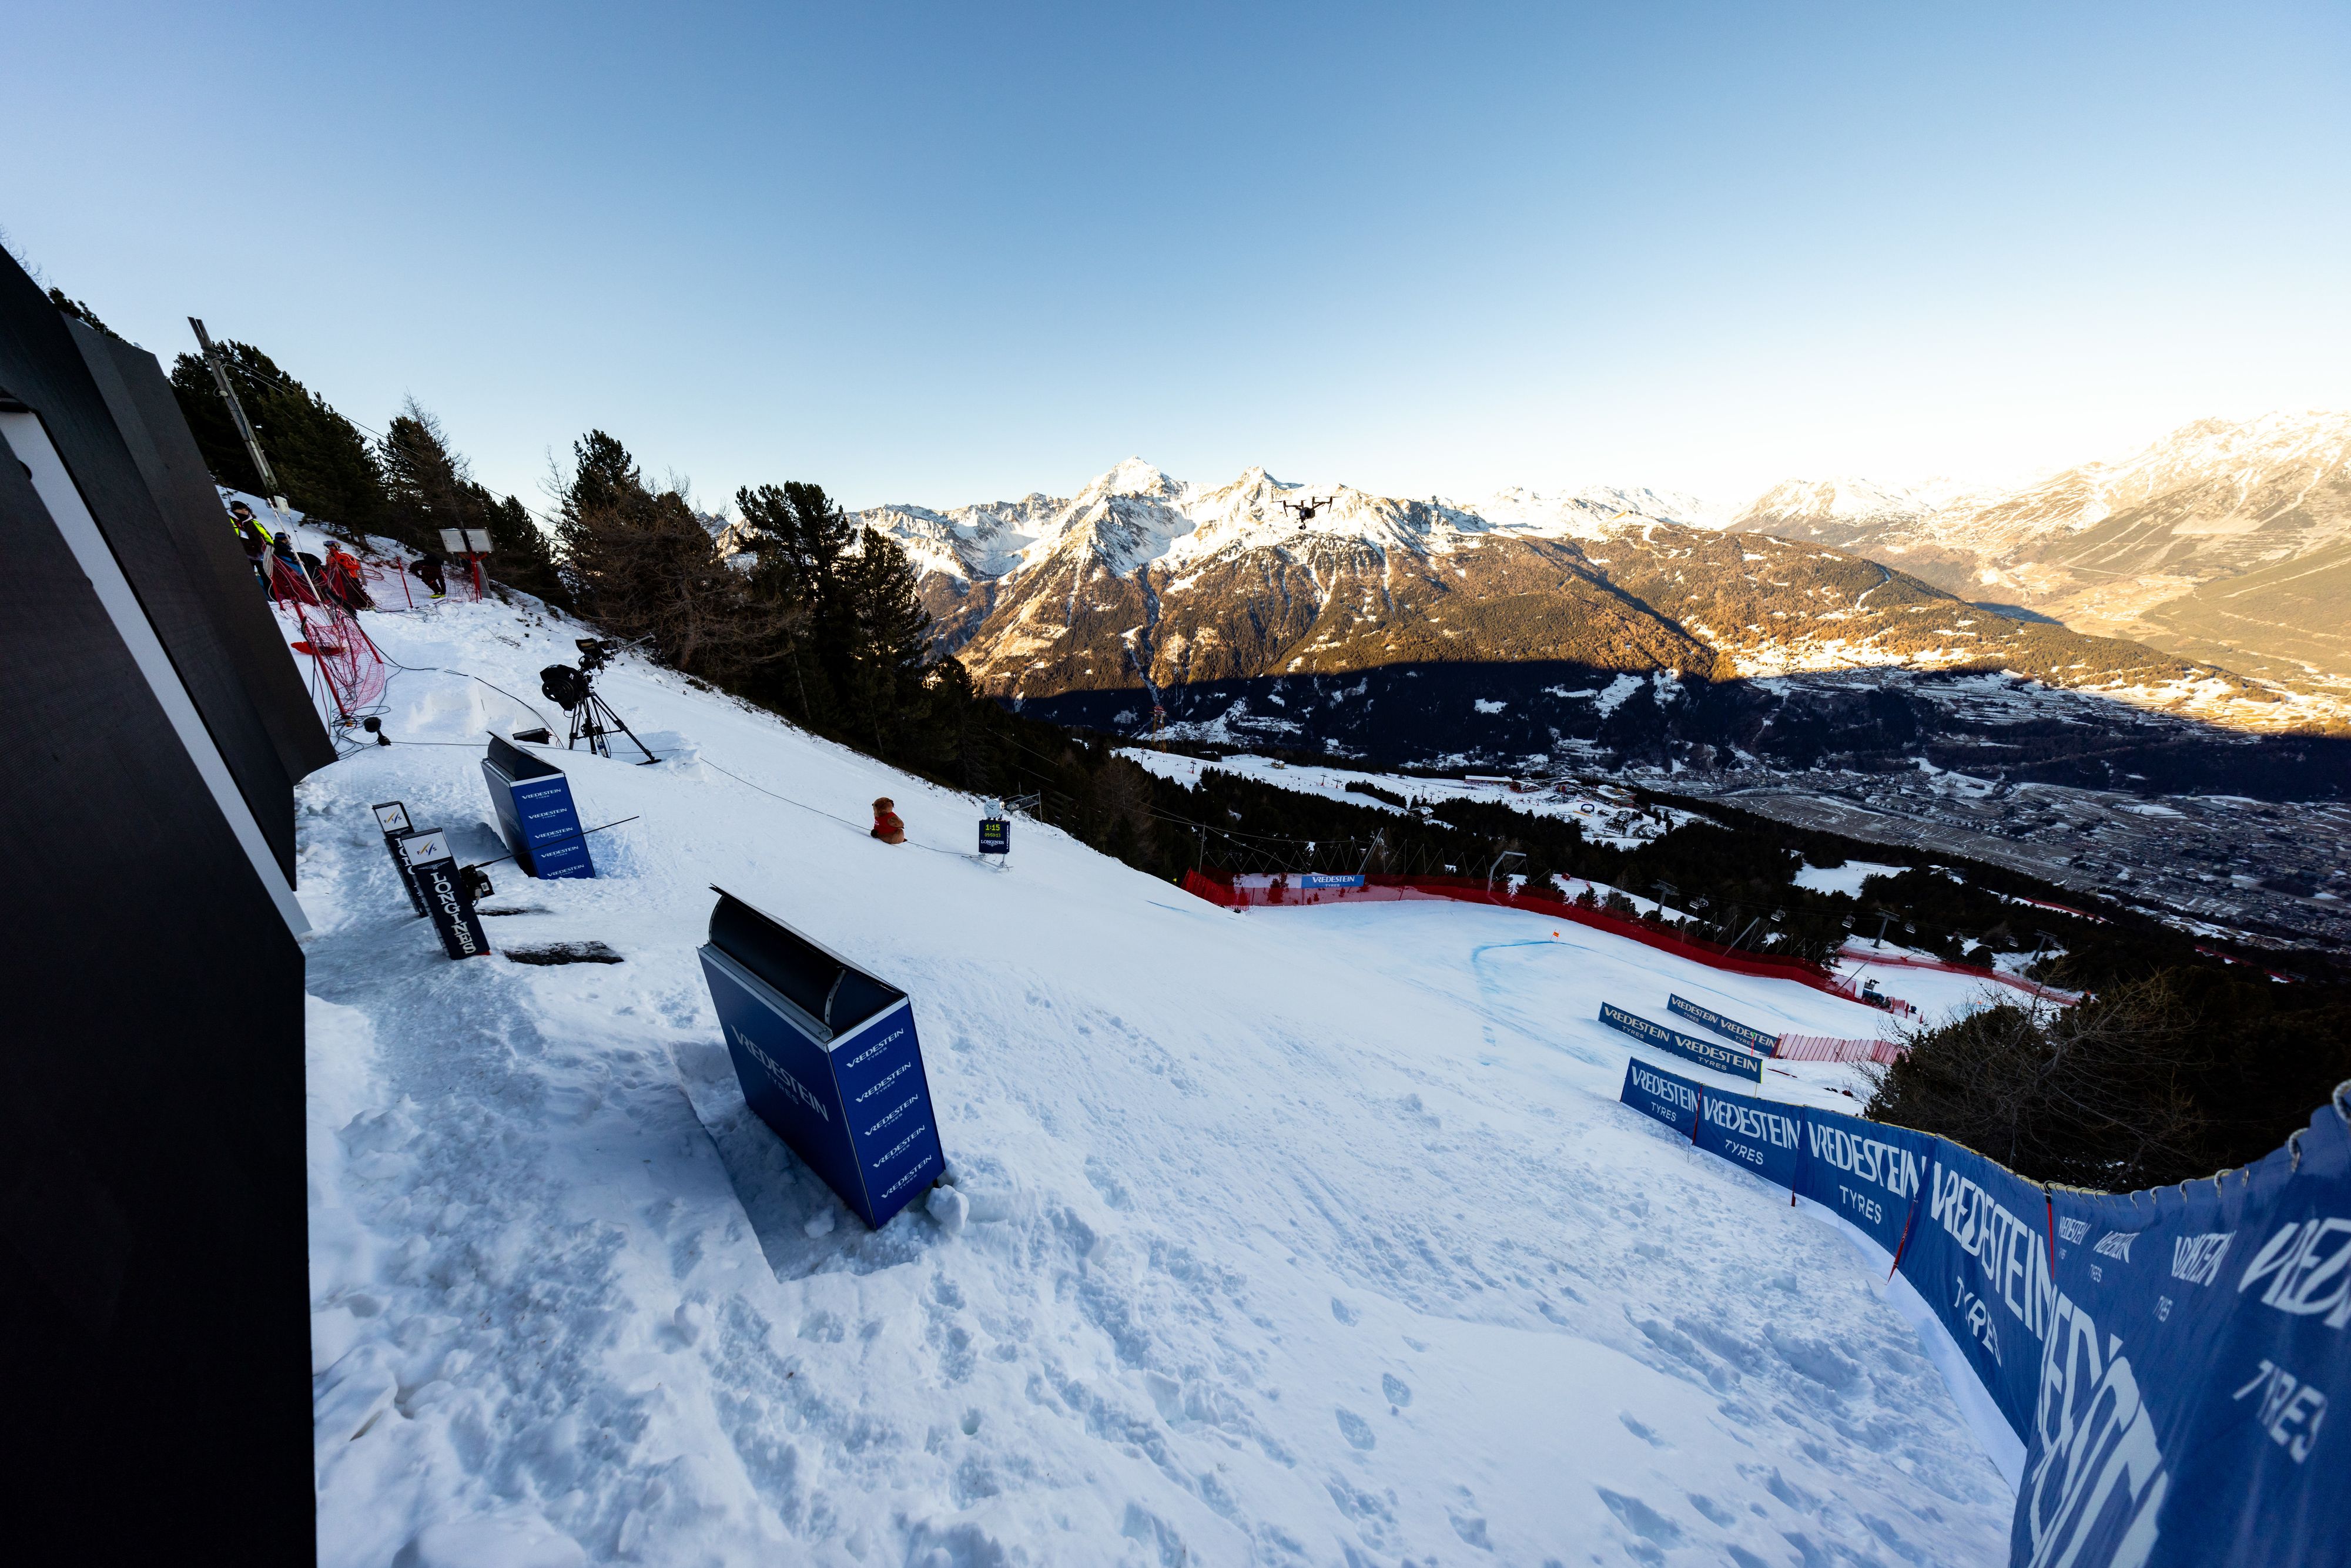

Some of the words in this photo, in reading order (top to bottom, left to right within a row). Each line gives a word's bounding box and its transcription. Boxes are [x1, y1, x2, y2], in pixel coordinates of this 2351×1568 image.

[522, 788, 561, 799] VREDESTEIN
[528, 808, 567, 819] VREDESTEIN
[534, 827, 573, 839] VREDESTEIN
[541, 846, 579, 858] VREDESTEIN
[547, 864, 584, 877] VREDESTEIN
[430, 872, 477, 954] LONGINES
[1671, 996, 1719, 1023] VREDESTEIN
[1683, 1011, 1699, 1022] TYRES
[1604, 1006, 1670, 1042] VREDESTEIN
[1622, 1026, 1644, 1039] TYRES
[1721, 1019, 1776, 1048] VREDESTEIN
[846, 1028, 904, 1068] VREDESTEIN
[867, 1047, 887, 1061] TYRES
[1675, 1036, 1757, 1072] VREDESTEIN
[731, 1024, 829, 1122] VREDESTEIN
[1698, 1057, 1727, 1070] TYRES
[765, 1070, 799, 1105] TYRES
[855, 1061, 911, 1103] VREDESTEIN
[875, 1080, 895, 1095] TYRES
[1632, 1066, 1700, 1113] VREDESTEIN
[864, 1094, 918, 1136] VREDESTEIN
[883, 1113, 903, 1128] TYRES
[1650, 1101, 1677, 1122] TYRES
[1703, 1095, 1800, 1150] VREDESTEIN
[873, 1124, 925, 1168] VREDESTEIN
[892, 1144, 910, 1159] TYRES
[1725, 1139, 1763, 1165] TYRES
[1807, 1121, 1927, 1199] VREDESTEIN
[881, 1154, 932, 1198] VREDESTEIN
[899, 1174, 917, 1190] TYRES
[1839, 1185, 1881, 1225] TYRES
[1954, 1275, 2001, 1368] TYRES
